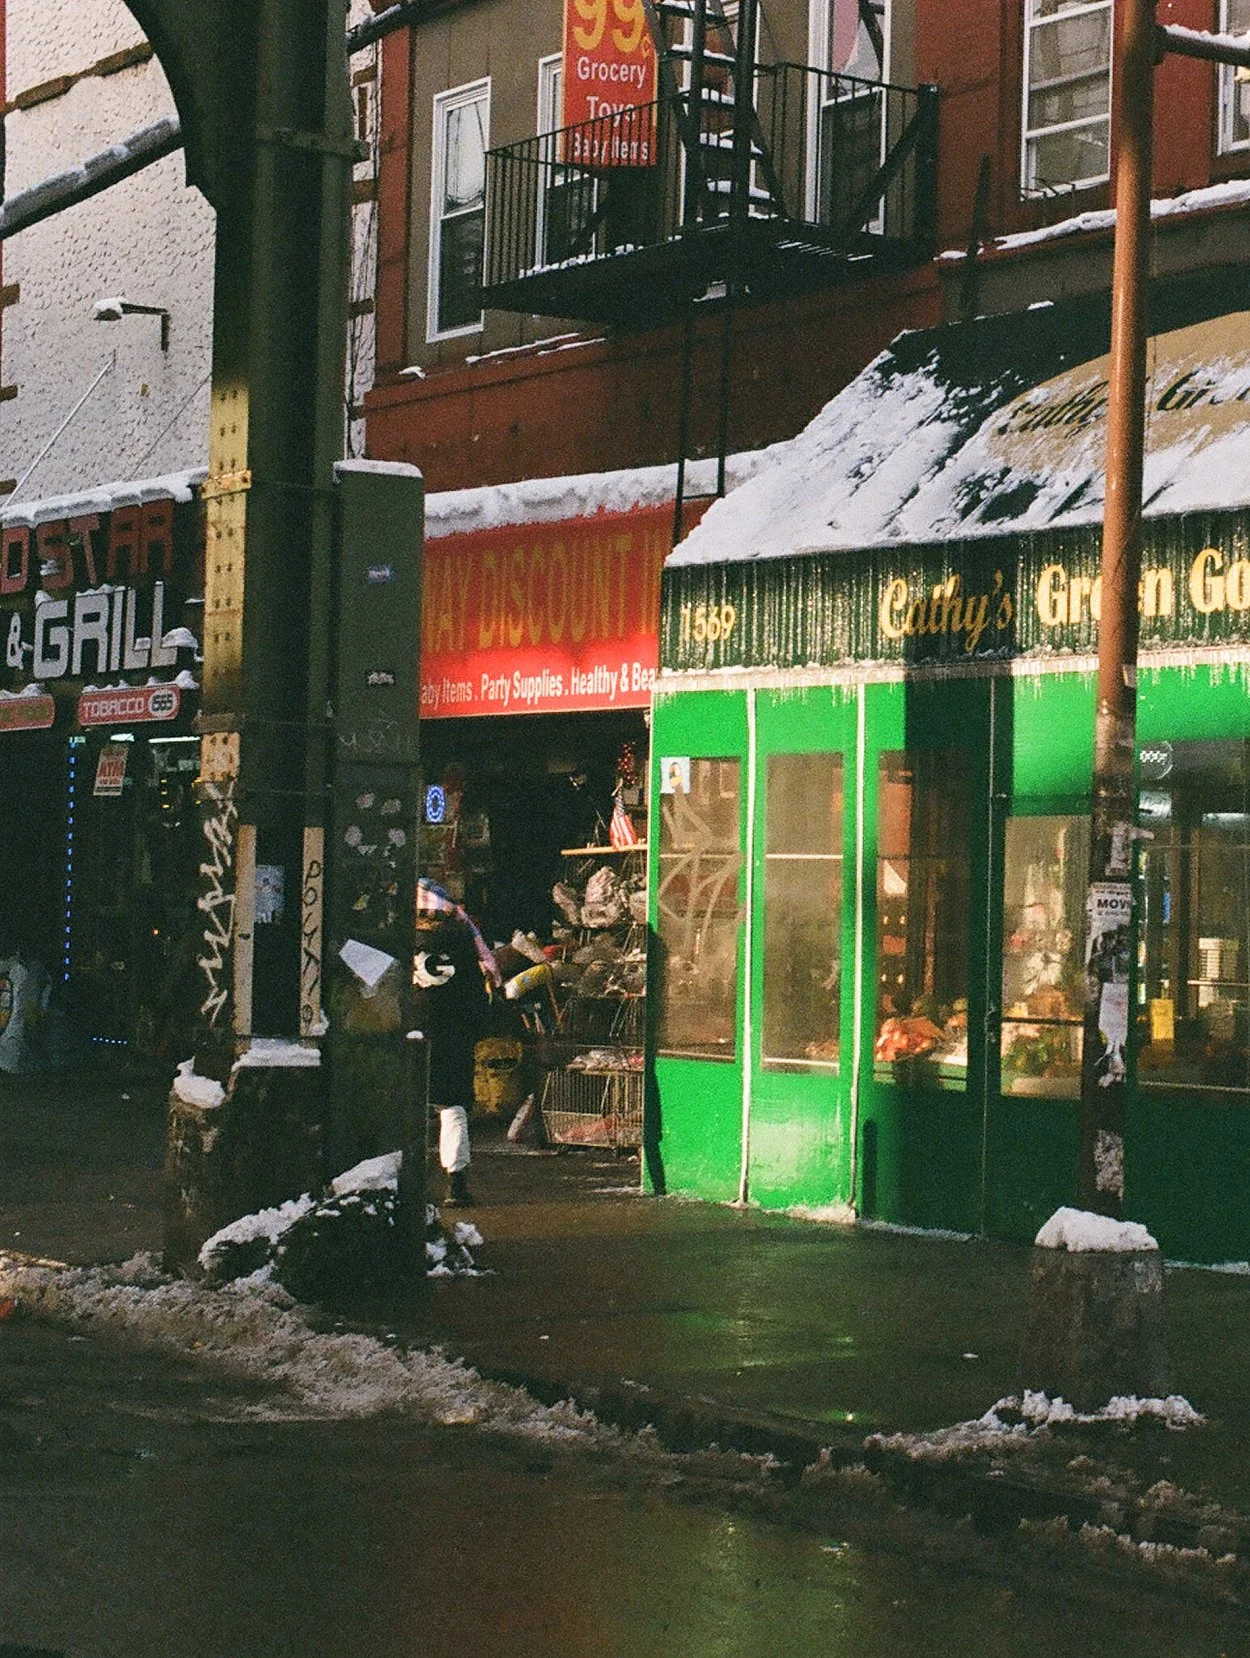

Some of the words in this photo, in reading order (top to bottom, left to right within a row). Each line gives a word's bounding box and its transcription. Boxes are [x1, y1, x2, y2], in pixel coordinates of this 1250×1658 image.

[576, 56, 646, 89] Grocery
[478, 534, 633, 649] DISCOUNT
[881, 569, 1013, 653] Cathy's
[1037, 564, 1173, 626] Grn
[33, 581, 178, 679] GRILL
[680, 604, 736, 642] 1569
[82, 696, 145, 718] TOBACCO
[420, 678, 442, 710] aby
[442, 676, 473, 704] Items
[481, 673, 511, 707] Party
[513, 669, 563, 705] Supplies
[571, 664, 618, 701] Healthy
[620, 662, 629, 693] &
[632, 661, 658, 692] Bea
